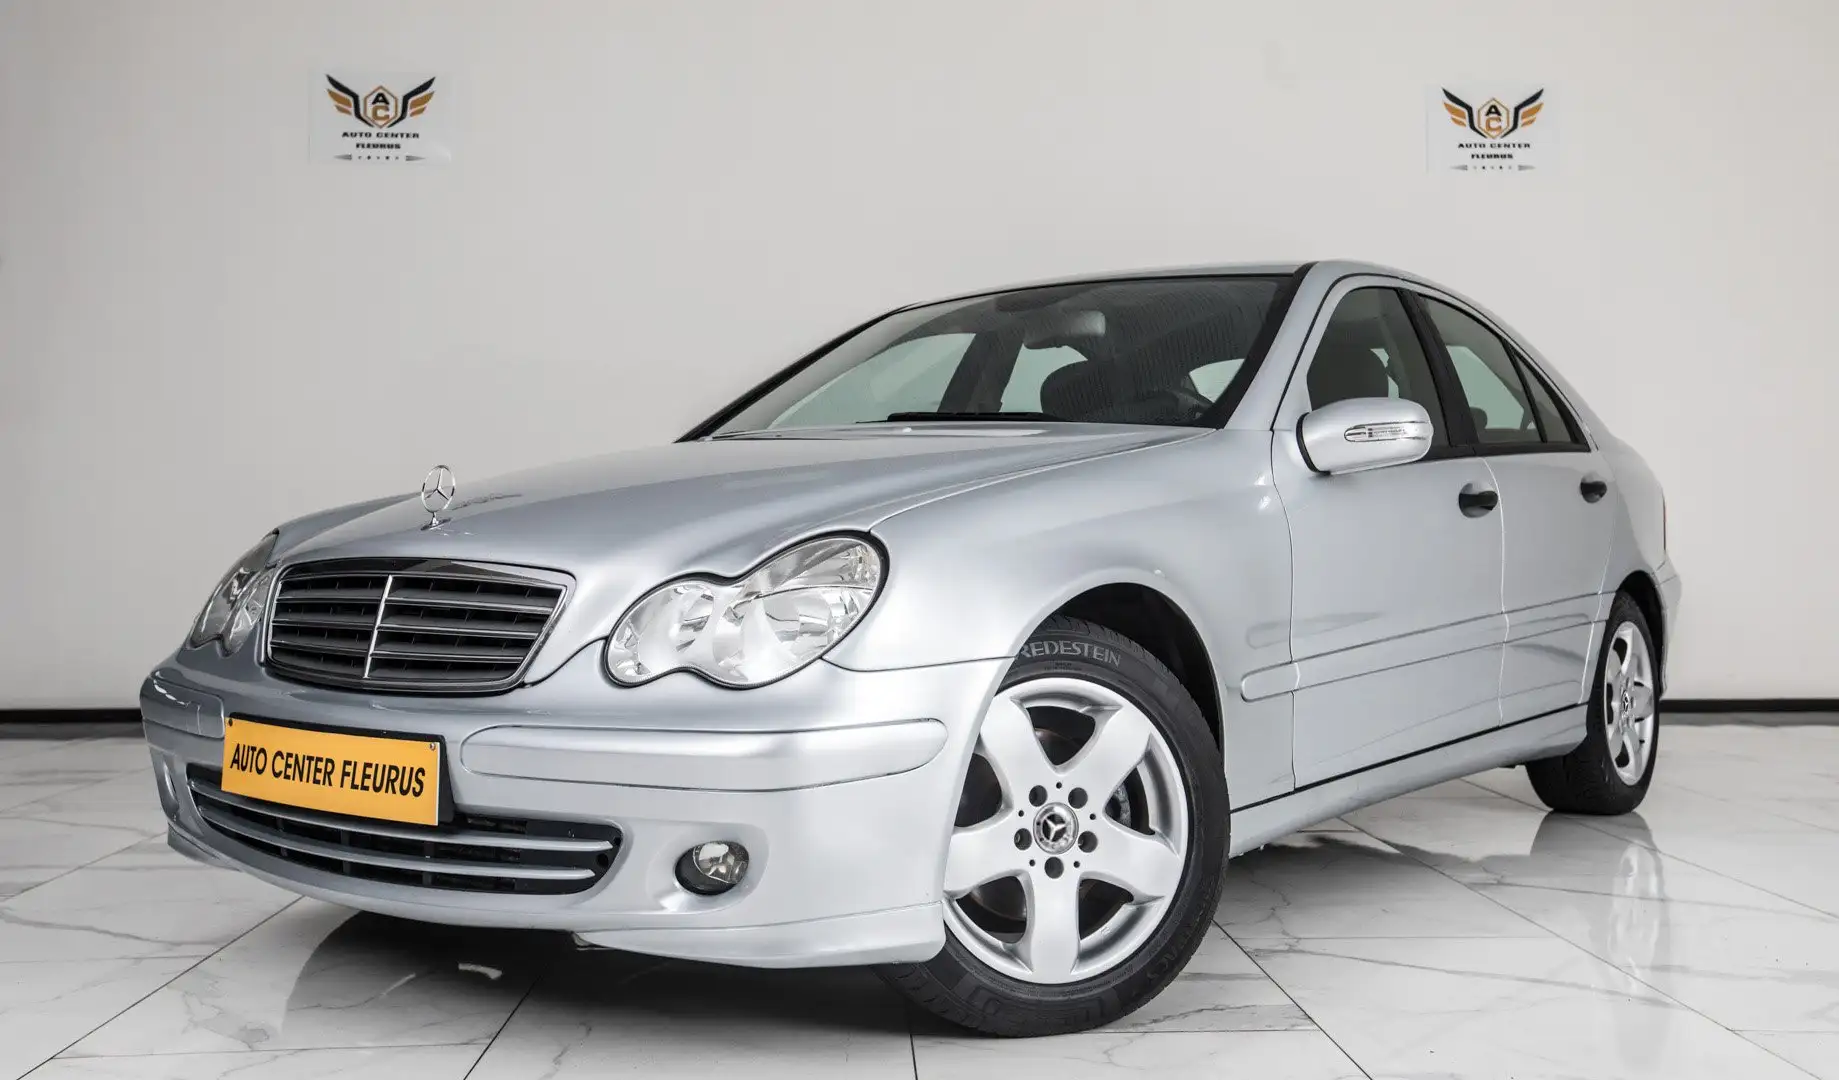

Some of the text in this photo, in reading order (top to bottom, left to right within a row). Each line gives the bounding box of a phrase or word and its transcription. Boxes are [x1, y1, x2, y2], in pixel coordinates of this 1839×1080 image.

[1020, 640, 1121, 668] REDESTEIN
[230, 743, 426, 798] AUTO CENTER FLEURUS
